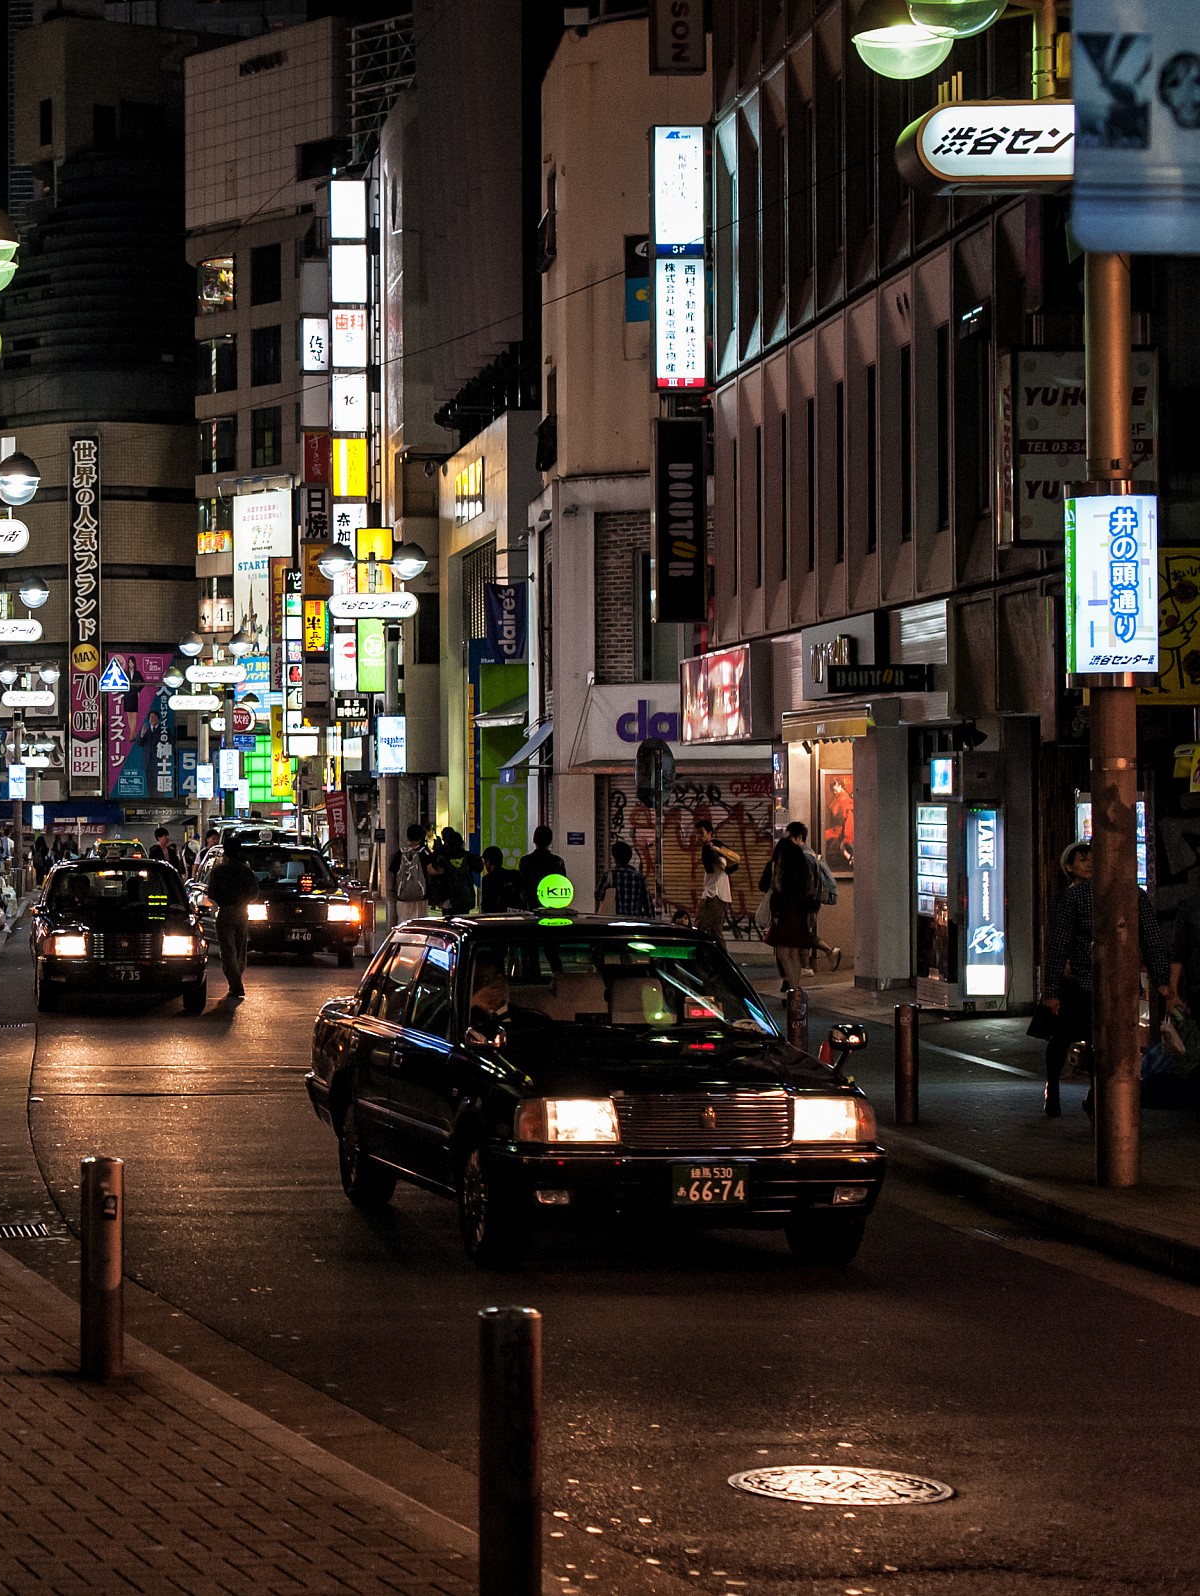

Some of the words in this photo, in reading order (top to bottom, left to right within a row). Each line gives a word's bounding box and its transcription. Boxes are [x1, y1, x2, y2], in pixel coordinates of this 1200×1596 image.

[668, 463, 697, 577] DOUTOR
[73, 441, 97, 641] 世界の人気ブランド
[1109, 507, 1138, 642] 井の頭通り
[497, 588, 516, 655] claire's
[73, 650, 97, 663] MAX
[73, 673, 98, 700] 70
[836, 668, 904, 686] DOUTOR
[82, 700, 98, 712] %
[337, 707, 367, 717] 田中ビル
[73, 711, 99, 731] OFF
[110, 692, 125, 766] ィーススーツ
[74, 747, 97, 757] B1F
[73, 761, 98, 772] B2F
[503, 795, 518, 822] 3
[977, 819, 994, 867] LARK
[714, 1167, 732, 1178] 530
[689, 1180, 745, 1201] 66-74
